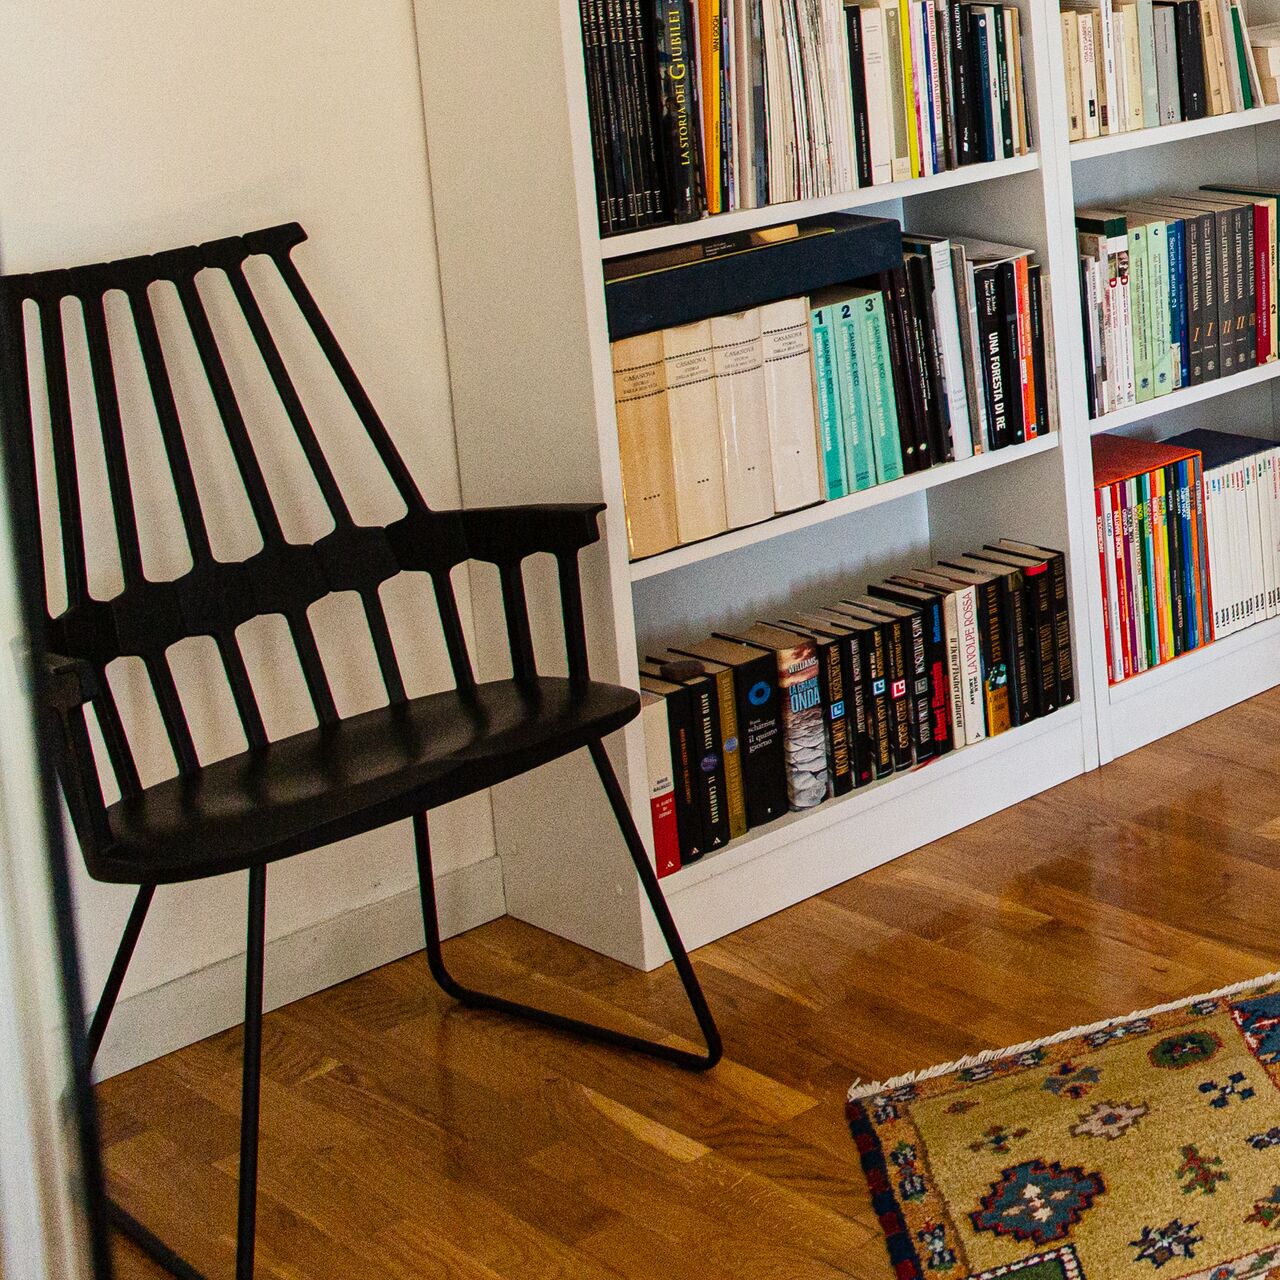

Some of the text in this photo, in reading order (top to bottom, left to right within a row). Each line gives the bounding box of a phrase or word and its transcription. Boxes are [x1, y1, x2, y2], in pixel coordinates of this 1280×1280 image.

[954, 3, 962, 50] AVANGUARDIA
[668, 10, 691, 165] LA STORIA DEI GIUBILEI
[1191, 244, 1200, 284] LETTERATURA
[1205, 239, 1213, 279] LETTERATURA
[814, 311, 824, 325] 1
[841, 305, 852, 319] 2
[724, 346, 754, 358] CASANOVA
[773, 331, 802, 343] CASANOVA
[624, 371, 656, 382] CASANOVA
[676, 357, 706, 368] CASANOVA
[989, 332, 1006, 431] UNA FORESTA DI RE
[963, 592, 978, 675] LA VOLPE ROSSA
[789, 656, 818, 673] WILLIAMS
[791, 689, 820, 713] ONDA
[701, 694, 712, 749] DAVID BALDACCI
[756, 728, 778, 742] quinto
[896, 700, 908, 748] TERZO GRADO
[749, 739, 772, 753] giorno
[832, 720, 848, 776] HONEYMOON
[709, 787, 718, 824] CANDIDATO
